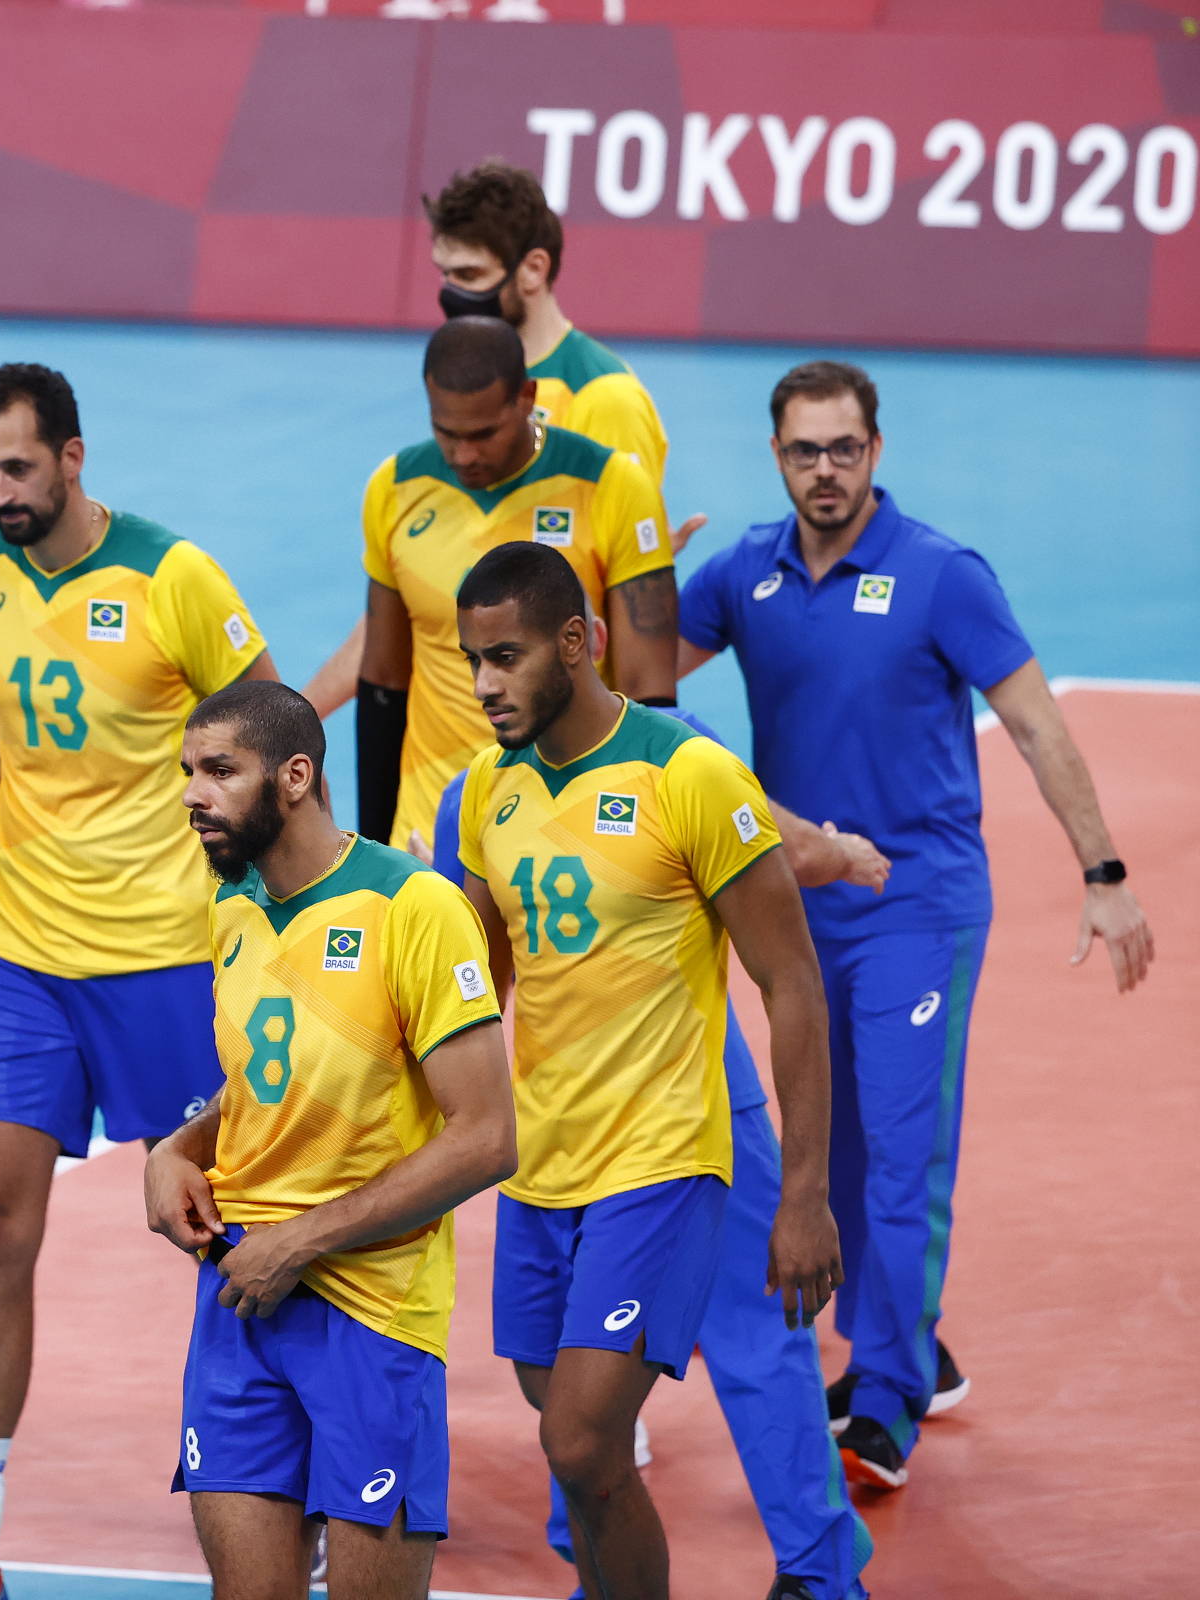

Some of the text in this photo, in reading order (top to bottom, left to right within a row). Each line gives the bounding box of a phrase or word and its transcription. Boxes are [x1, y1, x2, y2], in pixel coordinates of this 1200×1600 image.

[526, 107, 1198, 235] TOKYO 2020
[8, 657, 88, 752] 13
[597, 822, 632, 834] BRASIL
[510, 856, 600, 954] 18
[325, 958, 356, 969] BRASIL
[244, 997, 295, 1104] 8
[185, 1427, 202, 1470] 8
